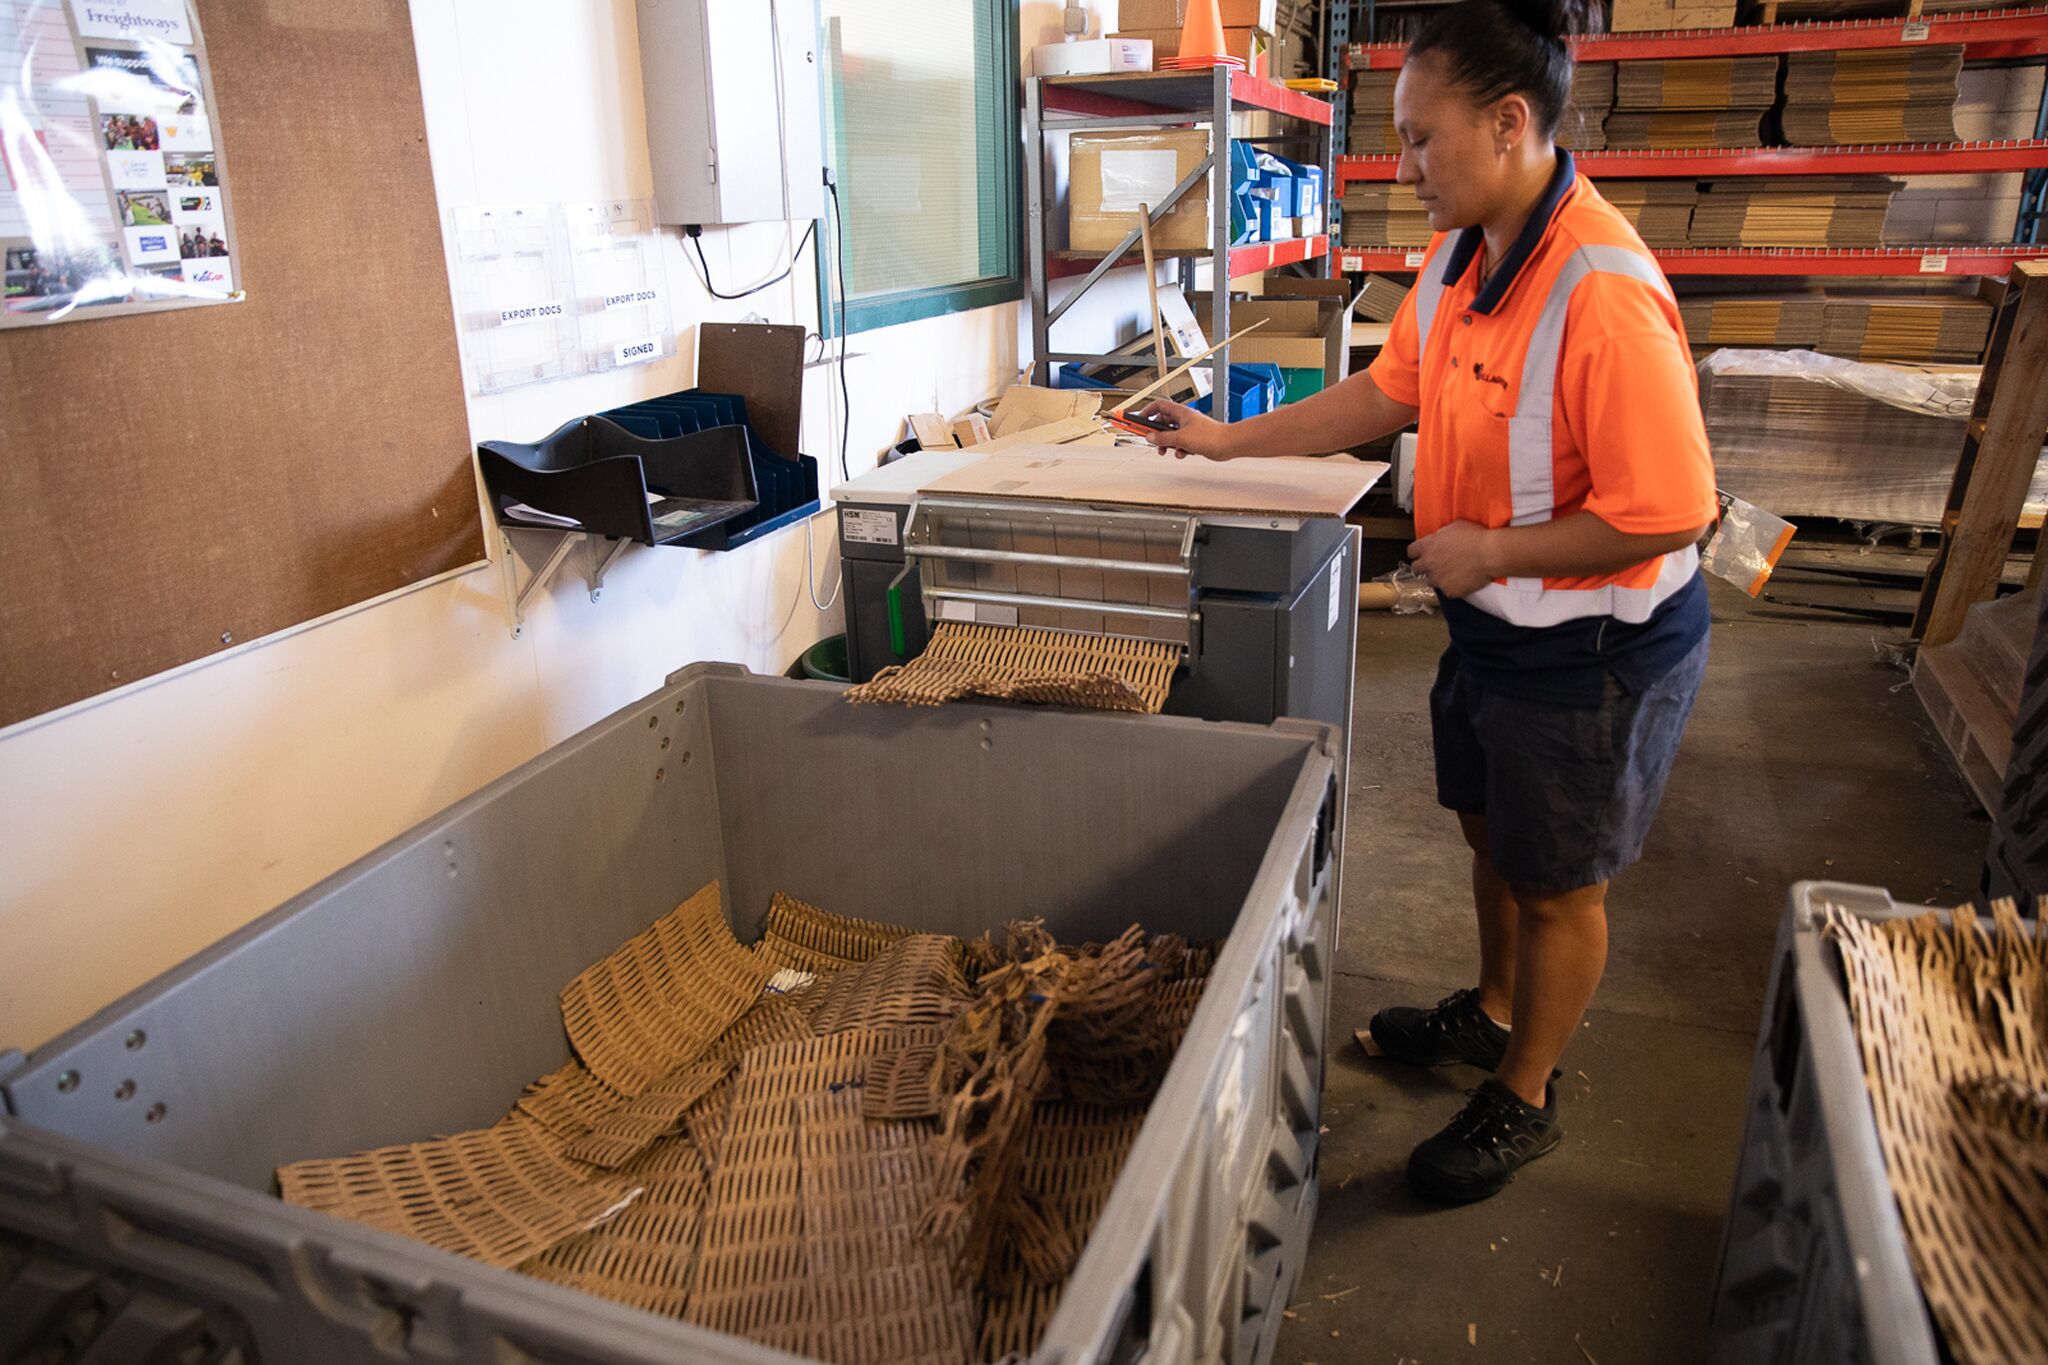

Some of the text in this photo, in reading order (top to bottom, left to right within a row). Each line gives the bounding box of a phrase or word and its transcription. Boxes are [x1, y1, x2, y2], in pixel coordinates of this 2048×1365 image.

[87, 8, 179, 34] Freightways
[605, 290, 657, 307] EXPORT DOCS
[501, 304, 563, 322] EXPORT DOCS
[622, 342, 655, 359] SIGNED
